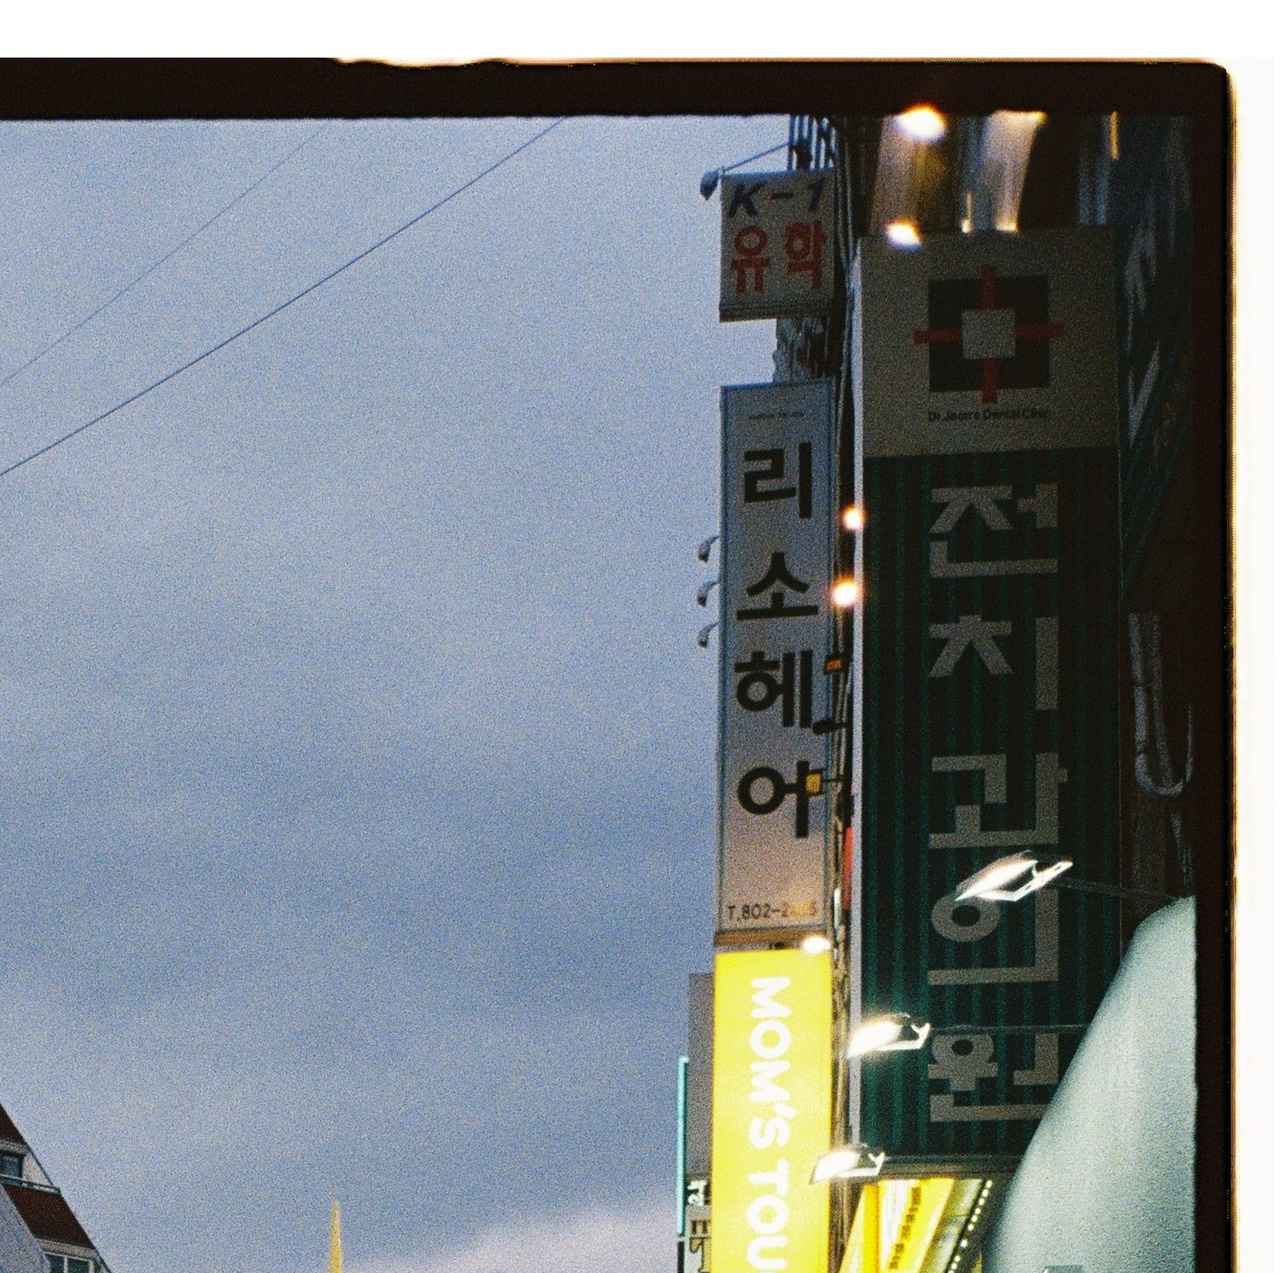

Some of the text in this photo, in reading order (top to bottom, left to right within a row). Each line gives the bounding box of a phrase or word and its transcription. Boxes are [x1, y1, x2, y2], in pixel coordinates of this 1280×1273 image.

[728, 178, 826, 218] K-1
[731, 220, 826, 293] 유학
[733, 440, 820, 838] 리소헤어
[748, 976, 791, 1146] MOM'S
